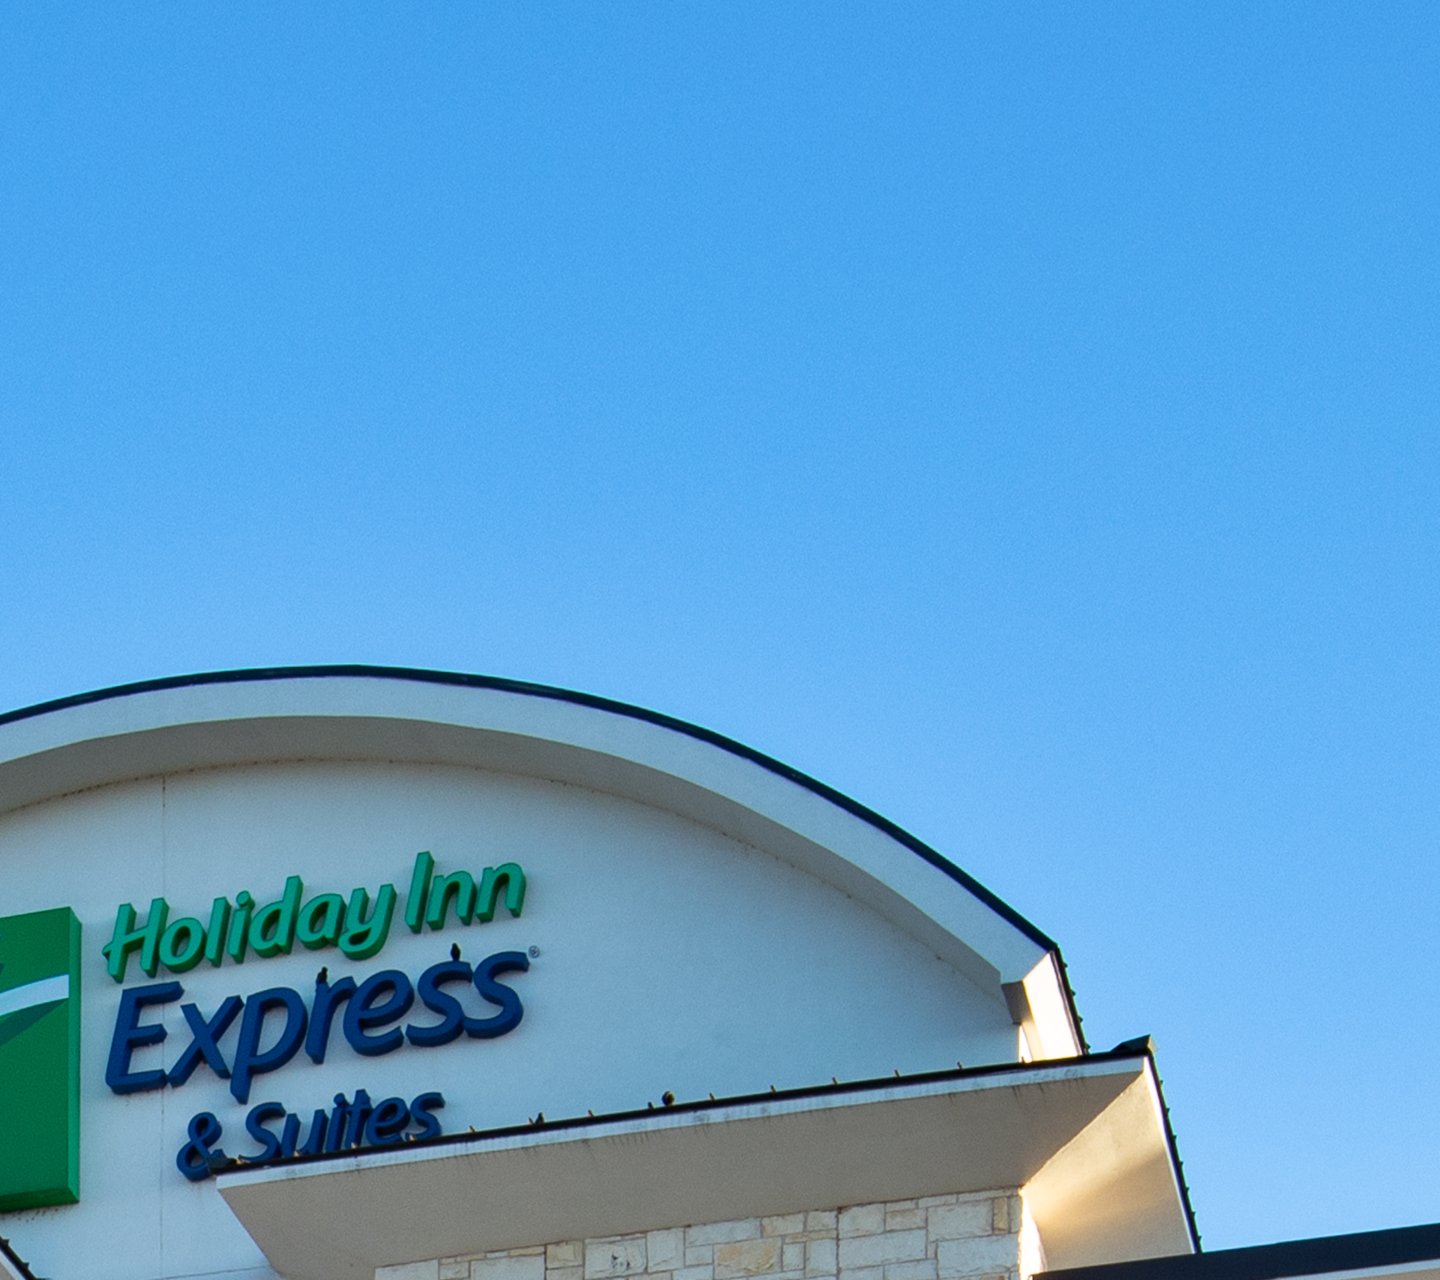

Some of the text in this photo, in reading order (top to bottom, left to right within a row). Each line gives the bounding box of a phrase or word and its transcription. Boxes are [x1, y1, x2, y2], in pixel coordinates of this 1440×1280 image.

[102, 851, 526, 983] Holiday Inn
[105, 951, 529, 1104] Express
[176, 1088, 445, 1182] & Suites
